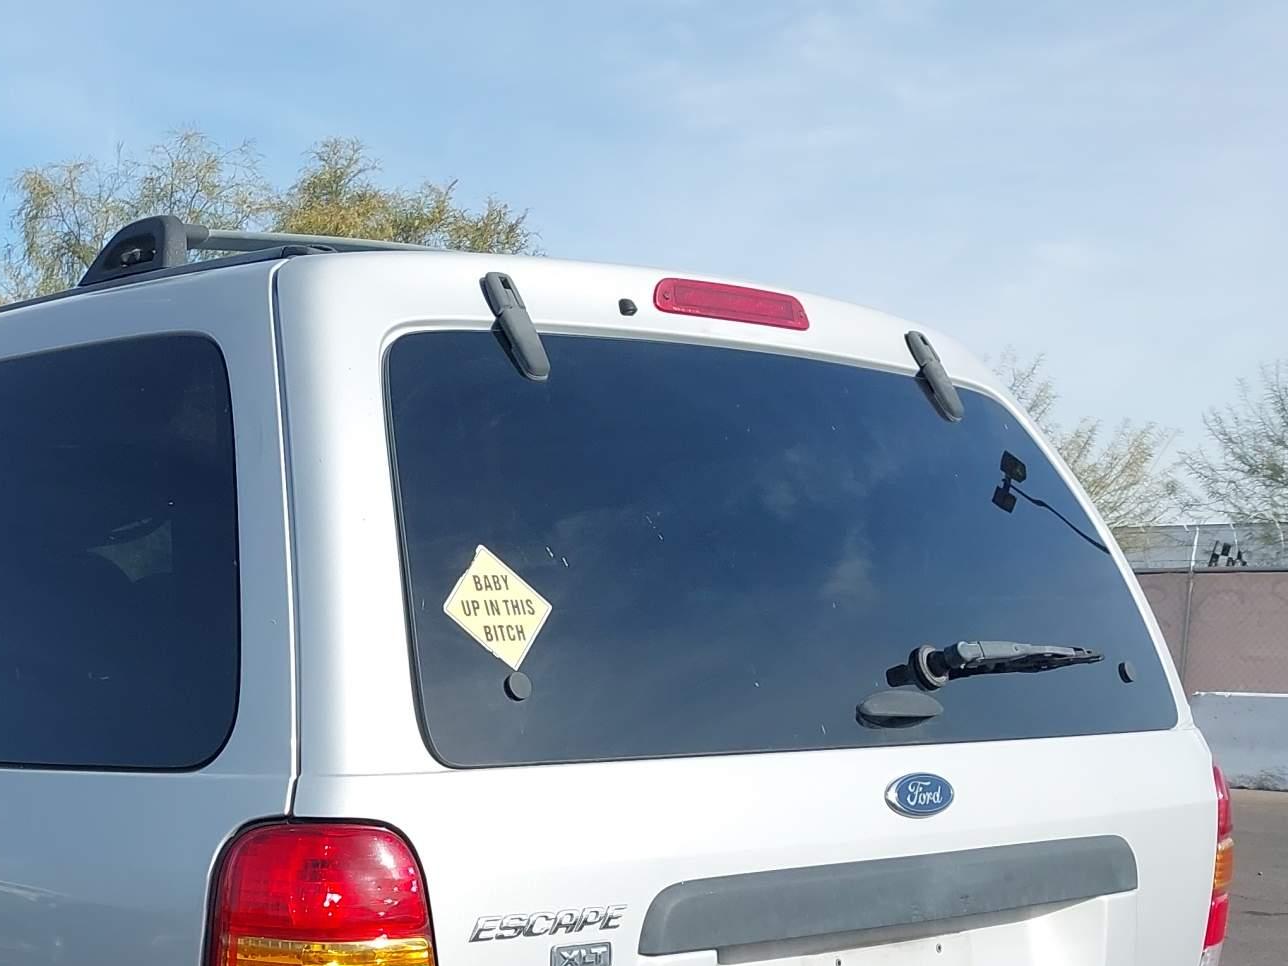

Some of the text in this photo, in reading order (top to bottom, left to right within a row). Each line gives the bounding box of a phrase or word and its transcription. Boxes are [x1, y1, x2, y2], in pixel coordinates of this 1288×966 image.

[472, 575, 510, 591] BABY
[461, 599, 536, 617] UP IN THIS
[483, 624, 526, 642] BITCH
[906, 780, 943, 806] Ford
[468, 903, 628, 943] ESCAPE
